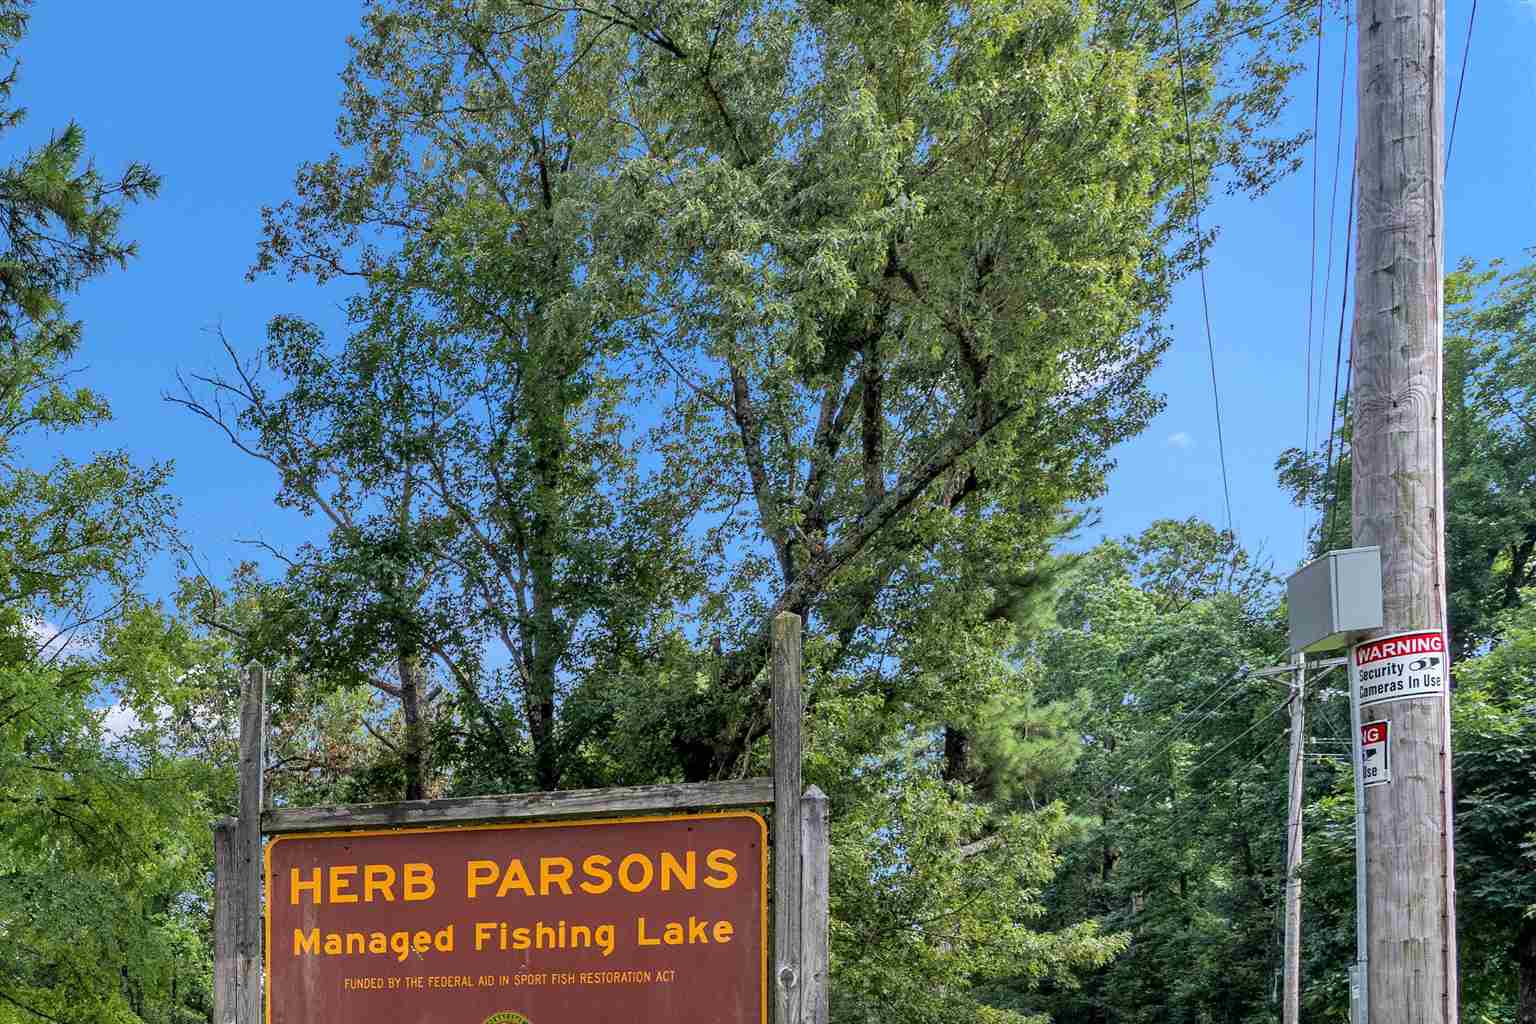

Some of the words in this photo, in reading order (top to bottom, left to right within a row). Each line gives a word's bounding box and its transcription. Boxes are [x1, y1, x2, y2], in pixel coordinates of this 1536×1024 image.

[1358, 637, 1442, 664] WARNING
[1360, 663, 1404, 682] Security
[1360, 679, 1404, 698] Cameras
[1408, 675, 1420, 688] In
[1424, 674, 1441, 687] Use
[291, 863, 436, 904] HERB
[467, 849, 738, 898] PARSONS
[293, 925, 454, 961] Managed
[475, 921, 615, 956] Fishing
[638, 917, 735, 946] Lake
[344, 977, 384, 990] FUNDED
[388, 977, 401, 989] BY
[405, 976, 424, 988] THE
[428, 975, 474, 988] FEDERAL
[478, 975, 495, 987] AID
[499, 975, 509, 986] IN
[514, 973, 547, 986] SPORT
[552, 973, 575, 985] FISH
[580, 971, 651, 984] RESTORATION
[655, 970, 676, 983] ACT
